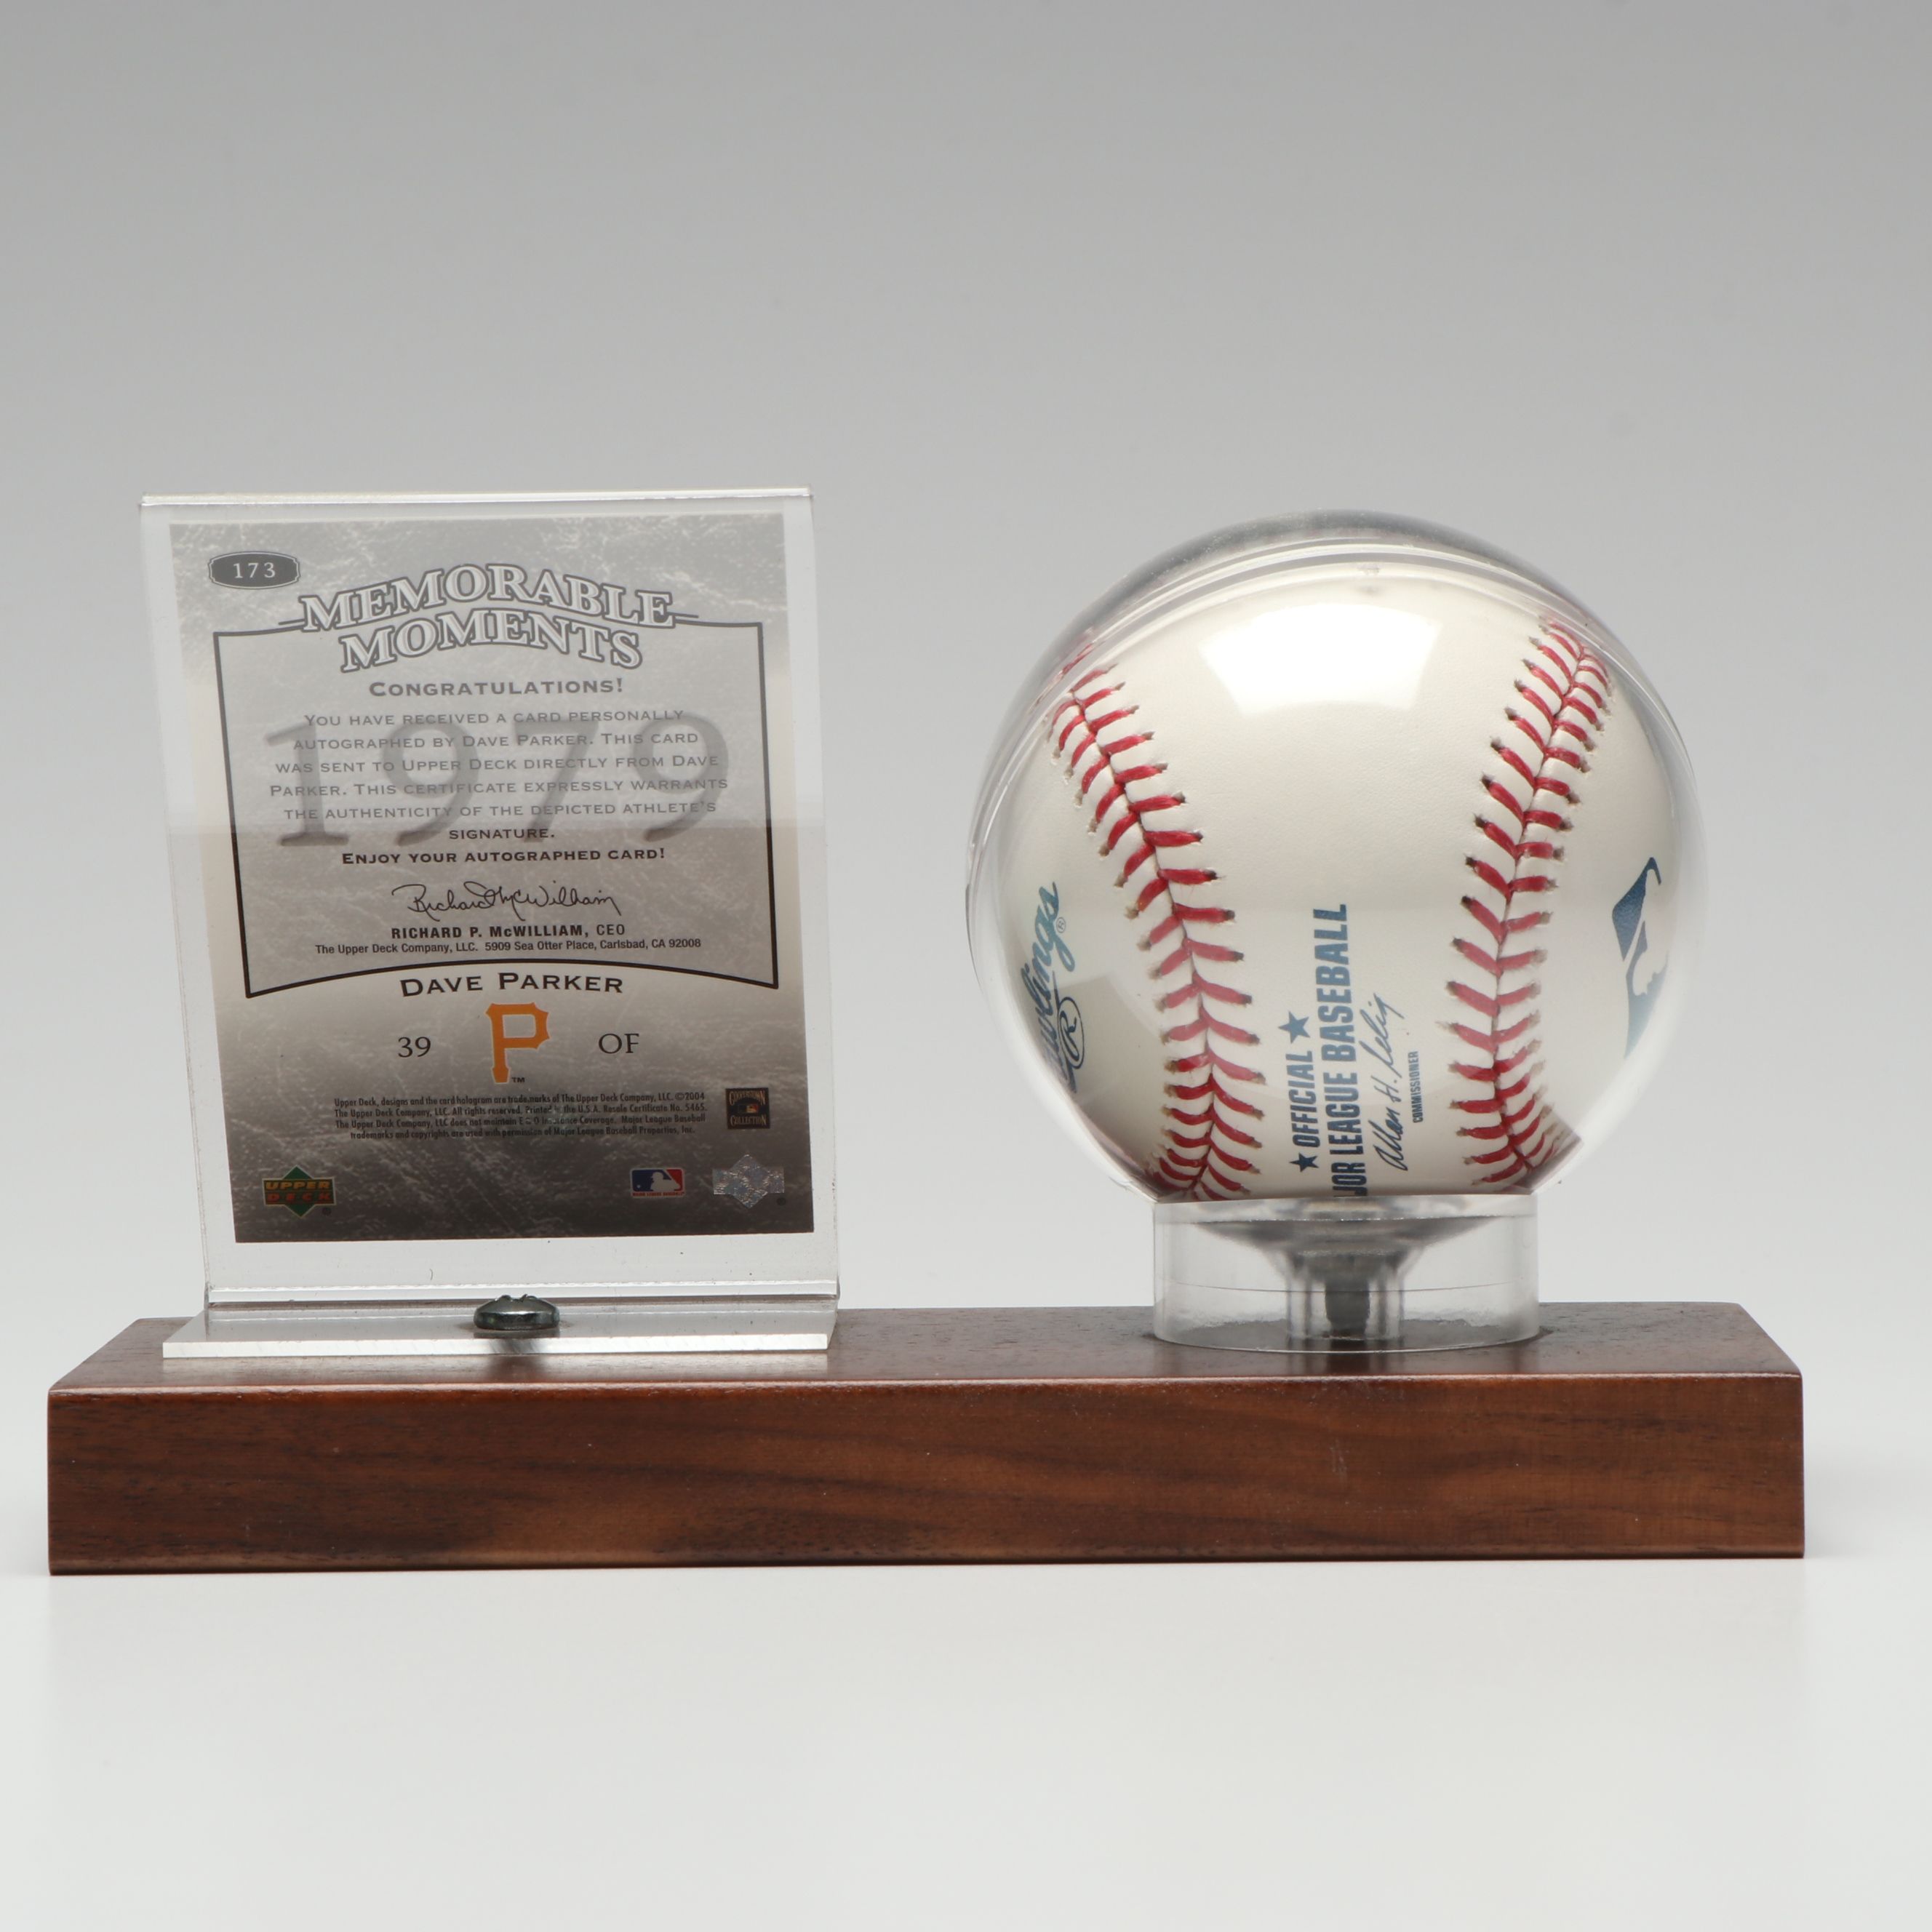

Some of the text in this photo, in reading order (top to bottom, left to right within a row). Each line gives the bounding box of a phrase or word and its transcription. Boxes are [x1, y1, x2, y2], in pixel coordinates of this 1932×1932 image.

[233, 560, 276, 580] 173
[298, 563, 676, 631] MEMORABLE
[340, 608, 643, 672] MOMENTS
[369, 678, 623, 697] CONGRATULATIONS!
[304, 710, 684, 726] YOU HAVE RECEIVED A CARD PERSONALLY
[294, 733, 698, 749] AUTOGRAPHED BY DAVE PARKER. THIS CARD
[275, 755, 719, 773] WAS SENT TO UPPER DECK DIRECTLY FROM DAVE
[271, 778, 727, 797] PARKER. THIS CERTIFICATE EXPRESSLY WARRANTS
[284, 809, 319, 820] THE
[325, 807, 452, 819] AUTHENTICITY
[460, 806, 482, 816] OF
[489, 806, 524, 816] THE
[531, 805, 615, 815] DEPICTED
[449, 828, 556, 839] SIGNATURE.
[342, 847, 665, 864] ENJOY YOUR AUTOGRAPHED CARD!
[391, 924, 626, 940] RICHARD P. McWILLIAM, CEO
[316, 938, 701, 956] The Upper Deck Company, LLC. 5909 Sea Otter Place, Carlsbad, CA 92008
[400, 972, 624, 997] DAVE PARKER
[397, 1036, 432, 1058] 39
[484, 1001, 550, 1084] P
[598, 1033, 639, 1055] OF
[1312, 903, 1368, 1197] JOR LEAGUE BASEBALL
[1408, 1050, 1424, 1123] COMMISSIONER
[335, 1098, 356, 1107] Upper
[358, 1098, 380, 1107] Deck,
[381, 1097, 409, 1106] designs
[410, 1096, 424, 1106] and
[426, 1095, 438, 1105] the
[439, 1095, 455, 1105] card
[456, 1095, 492, 1106] hologram
[552, 1094, 559, 1103] of
[562, 1094, 575, 1103] The
[576, 1094, 598, 1104] Upper
[601, 1093, 618, 1101] Deck
[620, 1093, 656, 1103] Company,
[658, 1093, 674, 1101] LLC.
[1285, 1050, 1321, 1148] OFFICIAL
[335, 1109, 348, 1117] The
[351, 1109, 372, 1119] Upper
[375, 1109, 393, 1117] Deck
[396, 1109, 432, 1118] Company,
[435, 1107, 450, 1116] LLC.
[452, 1107, 463, 1116] All
[464, 1107, 486, 1117] rights
[487, 1106, 521, 1114] reserved.
[564, 1105, 576, 1113] the
[578, 1104, 601, 1113] U.S.A.
[604, 1104, 627, 1113] Resale
[629, 1103, 668, 1112] Certificate
[670, 1103, 682, 1111] No.
[336, 1120, 349, 1128] The
[351, 1120, 374, 1129] Upper
[375, 1119, 394, 1127] Deck
[396, 1119, 433, 1129] Company,
[435, 1119, 450, 1127] LLC
[450, 1118, 467, 1126] does
[483, 1117, 516, 1126] maintain
[579, 1116, 615, 1126] Coverage.
[621, 1115, 642, 1125] Major
[645, 1114, 672, 1125] League
[674, 1114, 706, 1122] Baseball
[351, 1130, 394, 1139] trademarks
[396, 1130, 409, 1138] and
[410, 1129, 450, 1140] copyrights
[466, 1129, 482, 1138] used
[502, 1127, 543, 1138] permission
[545, 1127, 551, 1135] of
[553, 1127, 575, 1137] Major
[578, 1126, 604, 1136] League
[606, 1126, 637, 1135] Baseball
[639, 1125, 679, 1135] Properties,
[682, 1125, 695, 1133] Inc.
[266, 1181, 330, 1190] UPPER
